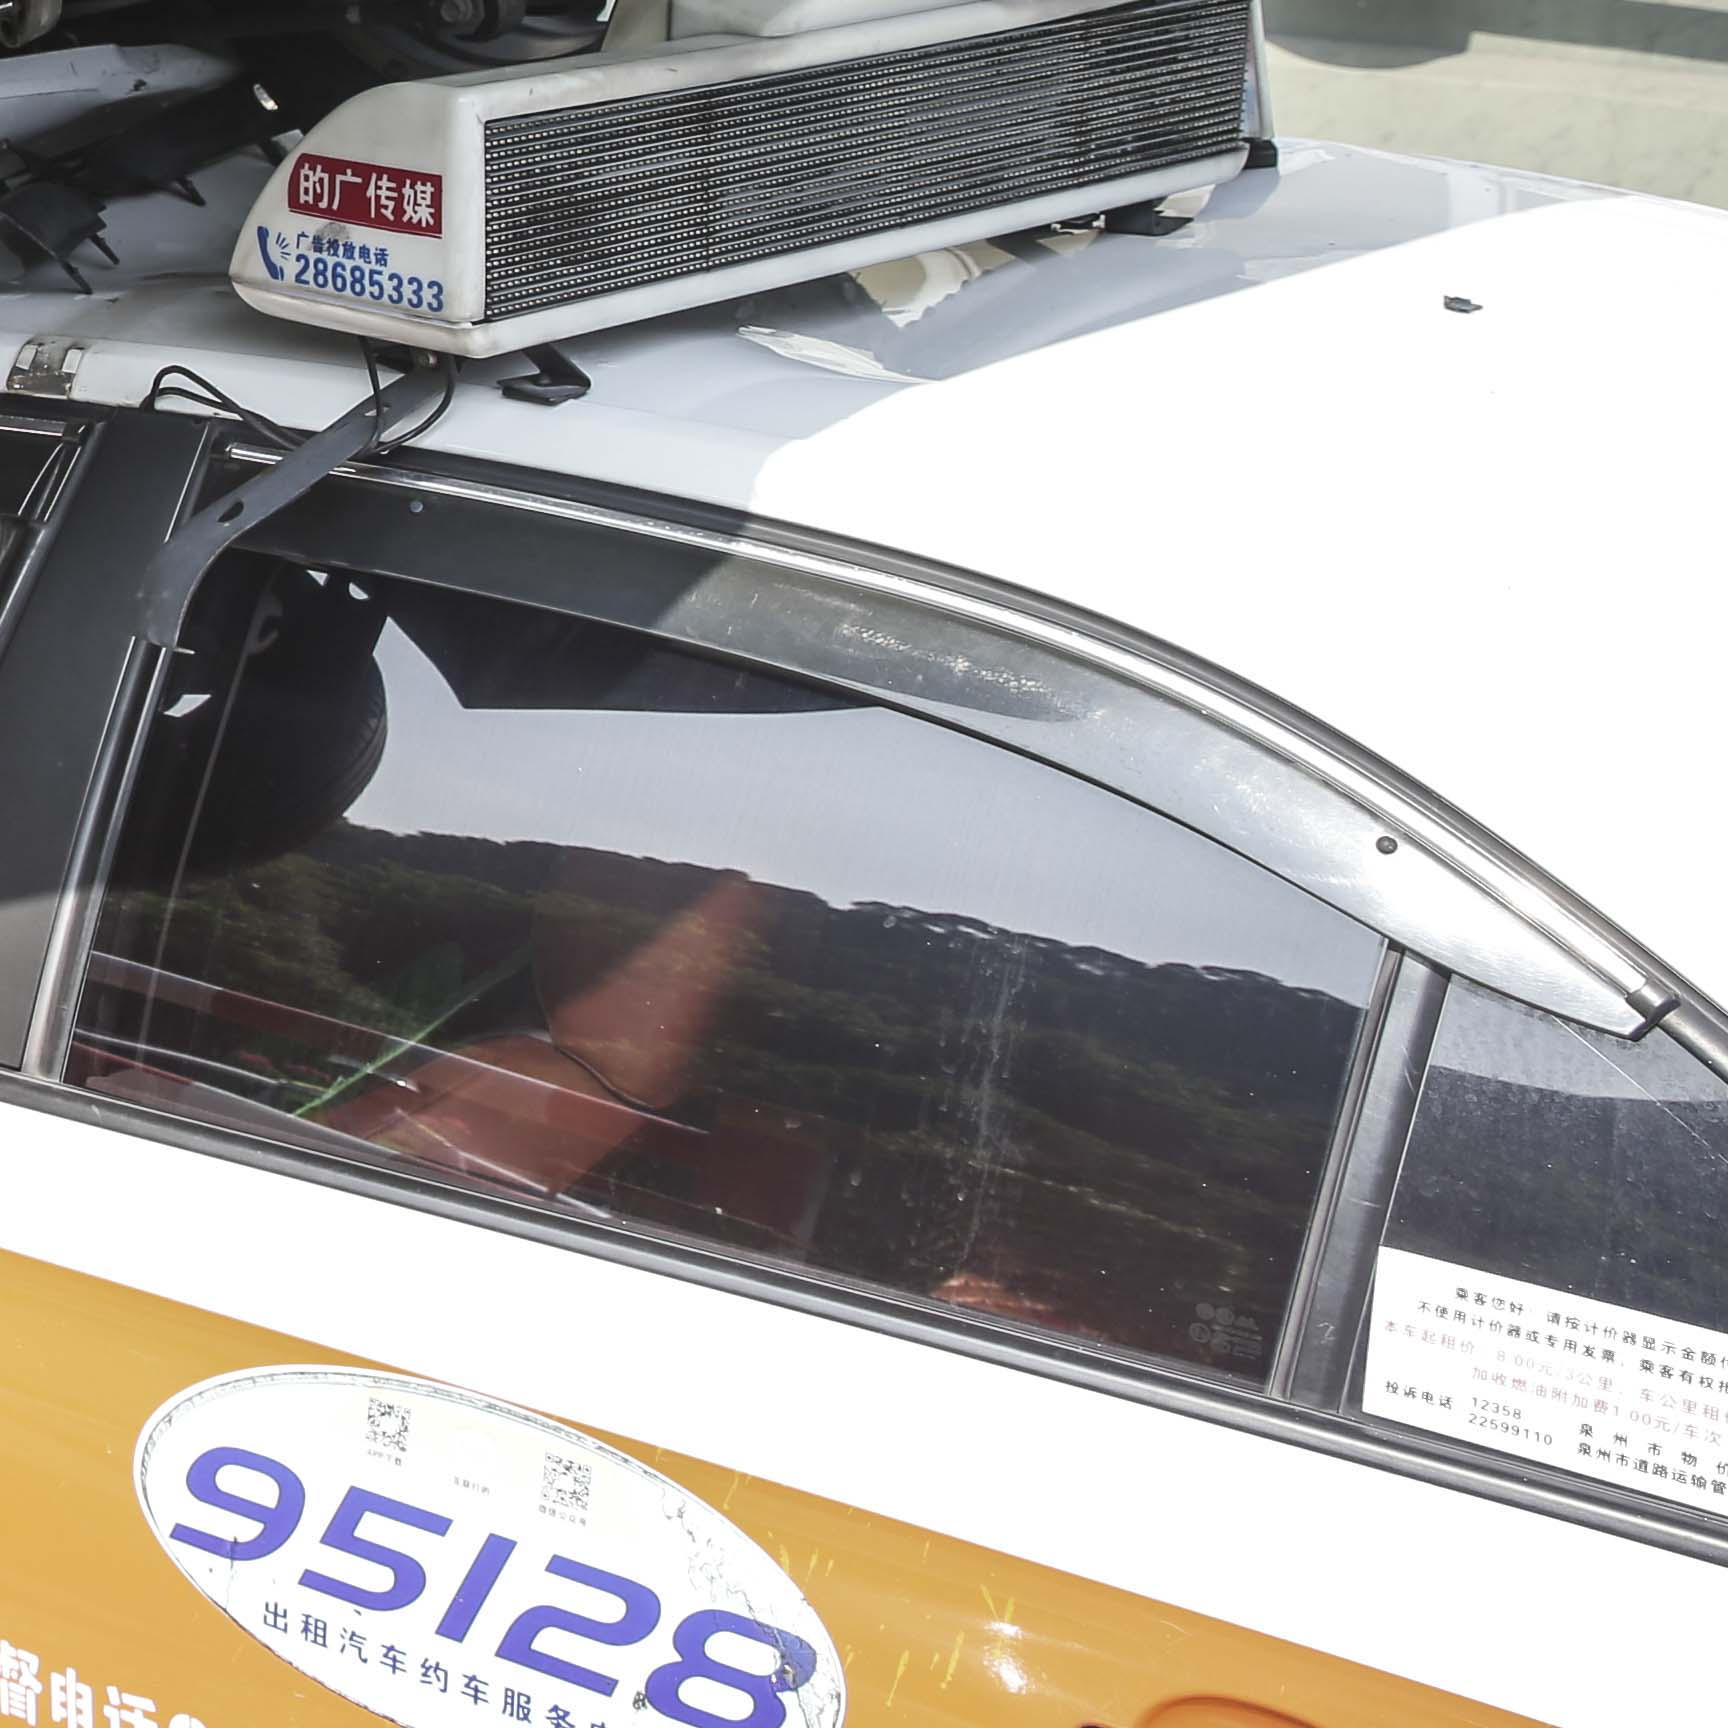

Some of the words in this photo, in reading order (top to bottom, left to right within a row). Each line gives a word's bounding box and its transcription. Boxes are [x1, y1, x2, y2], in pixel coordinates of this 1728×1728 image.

[298, 162, 436, 228] 的广传媒
[294, 231, 391, 269] 广告投放电话
[294, 253, 445, 313] 28685333
[1385, 1381, 1454, 1410] 投诉电话
[1472, 1397, 1522, 1420] 12358
[1468, 1413, 1553, 1446] 22599110
[169, 1446, 817, 1728] 95128
